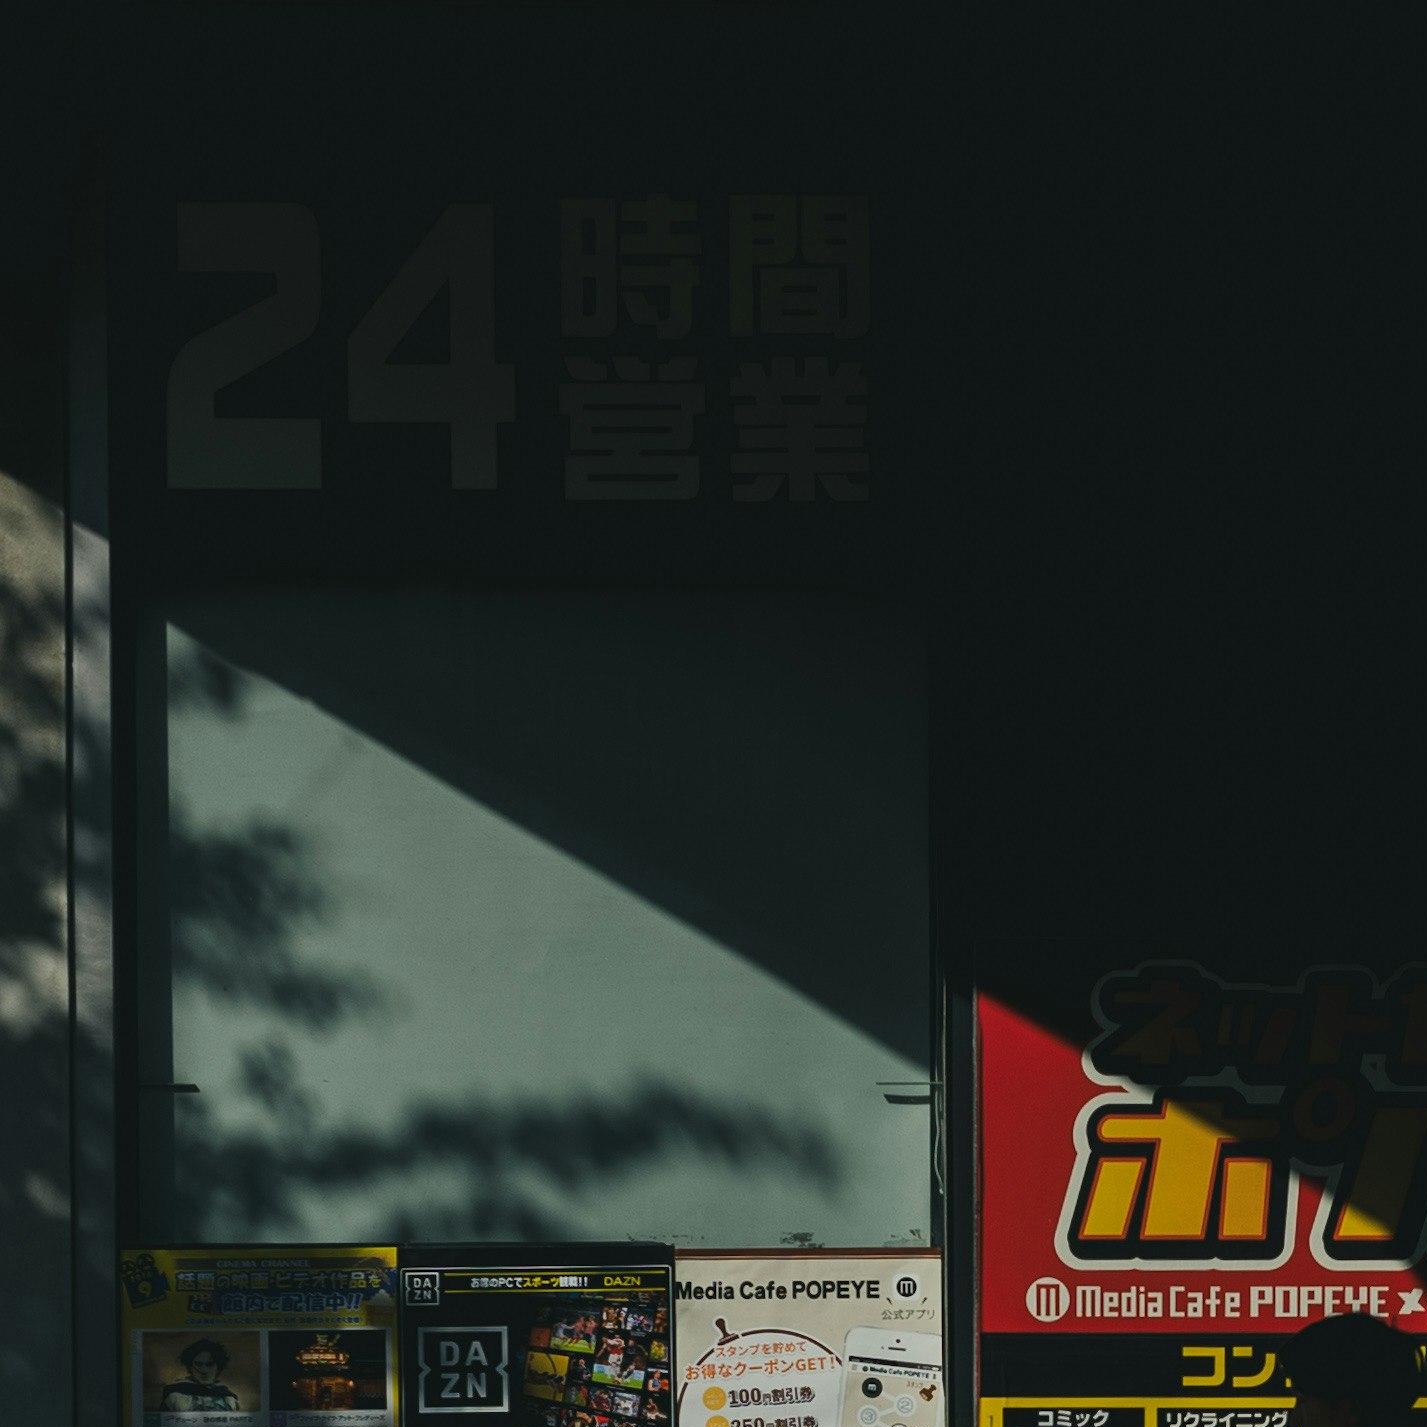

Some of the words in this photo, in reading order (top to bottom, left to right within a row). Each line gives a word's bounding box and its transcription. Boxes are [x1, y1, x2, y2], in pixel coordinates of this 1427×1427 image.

[559, 193, 871, 340] 時間
[166, 201, 516, 490] 24
[558, 355, 871, 503] 営業
[604, 1276, 641, 1286] DAZN
[676, 1280, 734, 1299] Media
[740, 1280, 787, 1299] Cafe
[792, 1280, 880, 1299] POPEYE
[1076, 1286, 1163, 1318] Media
[1170, 1286, 1240, 1318] Cafe
[1250, 1286, 1389, 1318] POPEYE
[881, 1310, 935, 1320] 公式アプリ
[440, 1341, 488, 1366] DA
[716, 1341, 806, 1358] スタンプを貯めて
[685, 1356, 836, 1381] お得なクーポンGET!
[441, 1373, 487, 1398] ZN
[728, 1386, 815, 1408] 100円割引券
[1037, 1410, 1109, 1427] コミック
